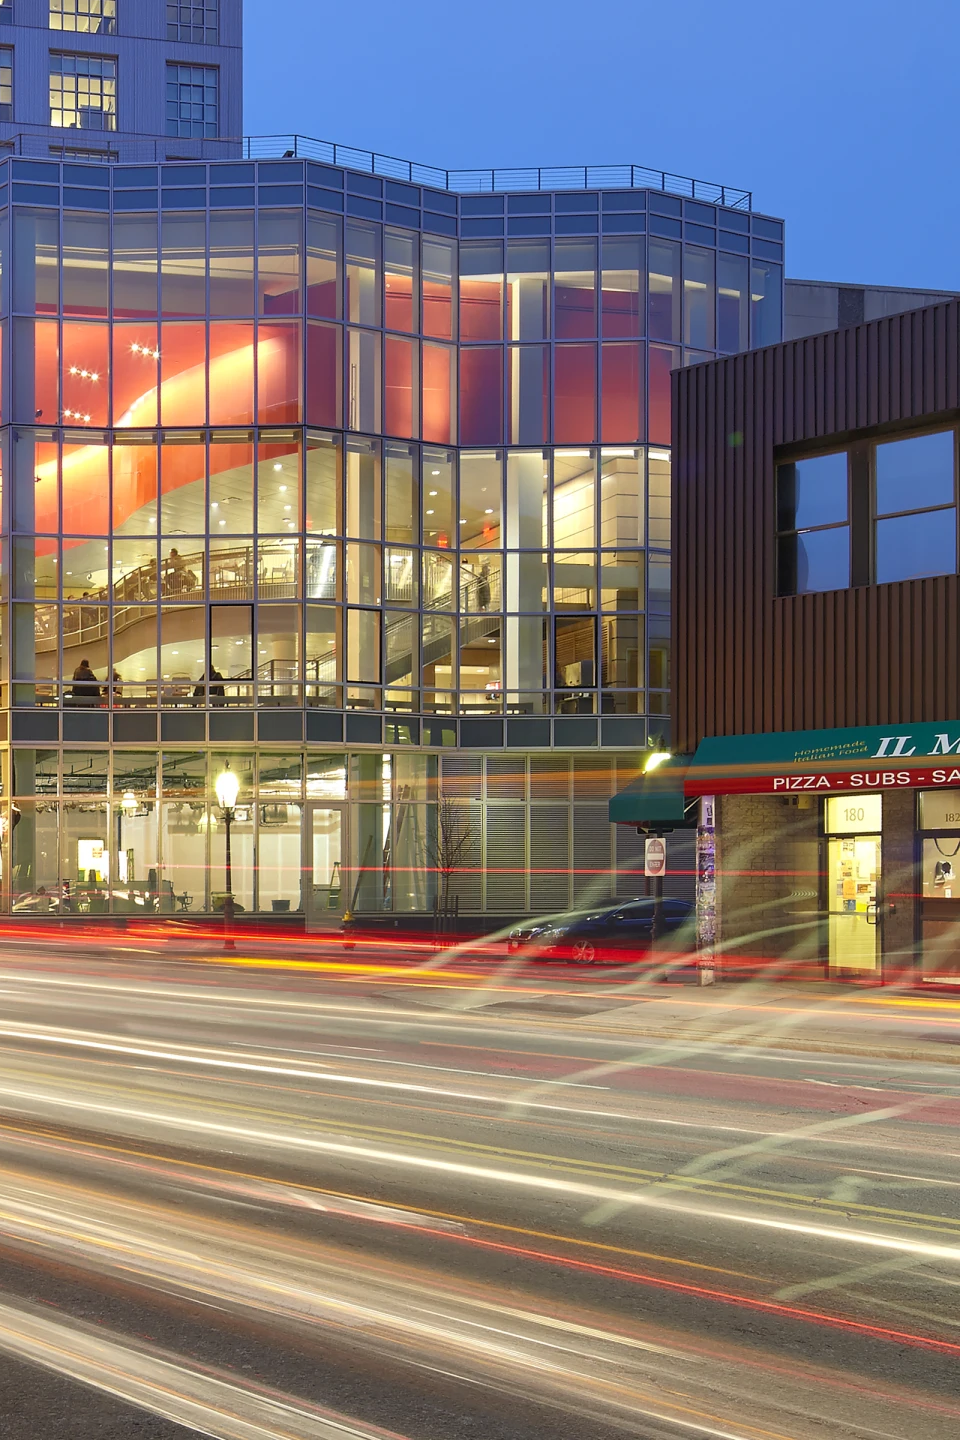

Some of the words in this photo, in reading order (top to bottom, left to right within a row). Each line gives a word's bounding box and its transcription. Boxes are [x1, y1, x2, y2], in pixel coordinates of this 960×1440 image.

[793, 752, 835, 764] Italian
[839, 745, 869, 756] Food
[794, 740, 866, 757] Homemade
[871, 735, 917, 758] IL
[773, 776, 831, 790] PIZZA
[850, 771, 911, 787] SUBS
[843, 807, 865, 822] 180
